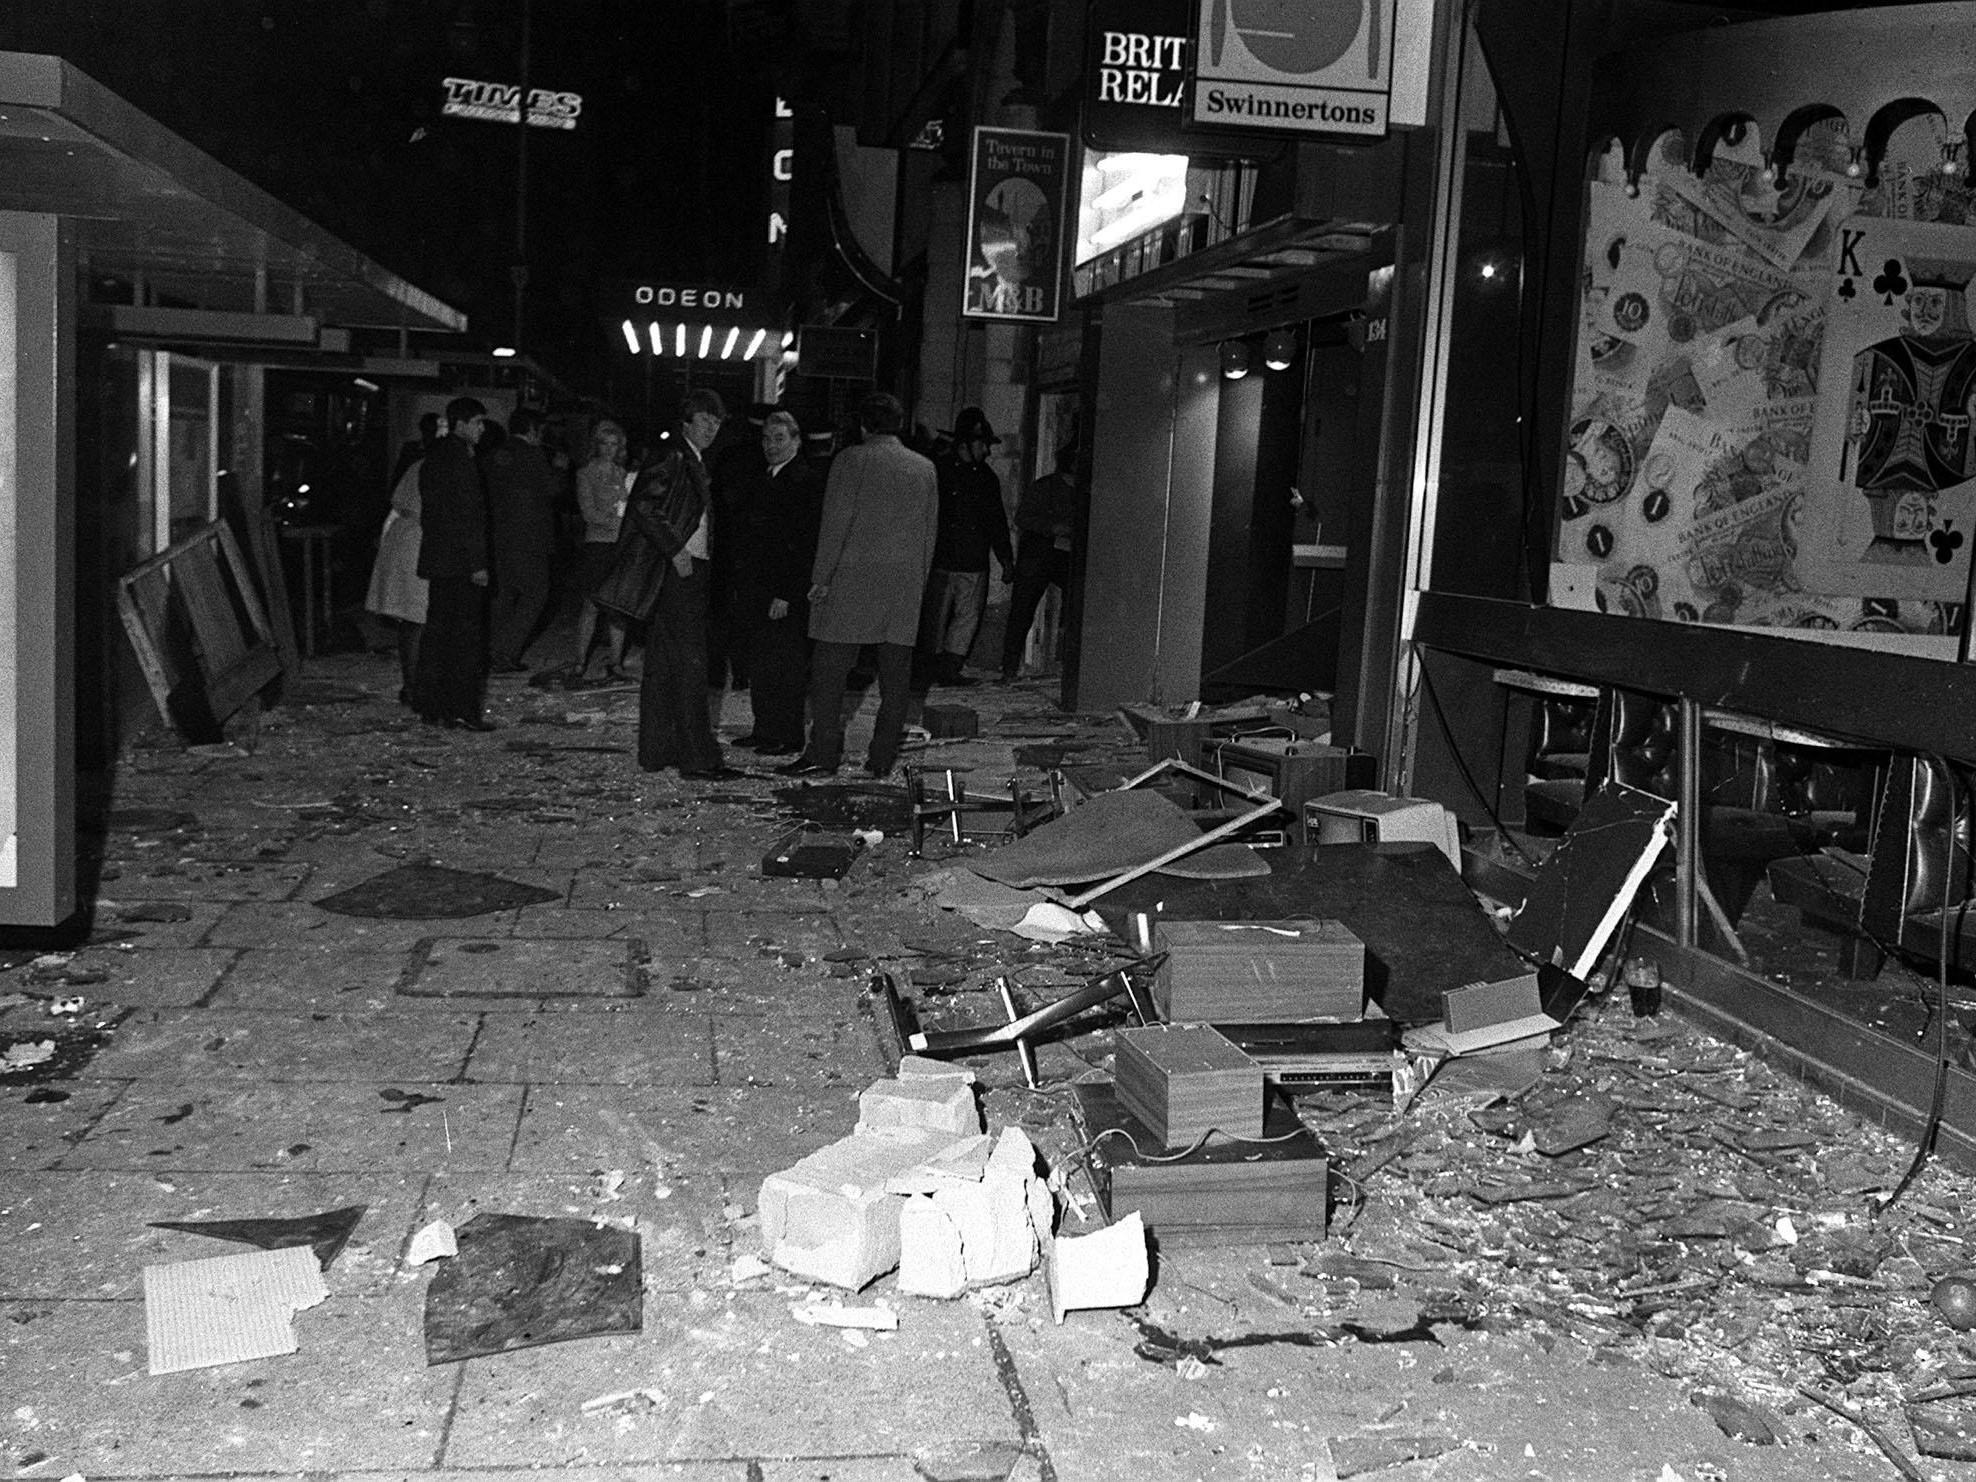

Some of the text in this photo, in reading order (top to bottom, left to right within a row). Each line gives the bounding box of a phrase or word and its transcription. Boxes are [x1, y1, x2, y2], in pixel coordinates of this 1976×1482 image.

[1102, 31, 1187, 70] BRIT
[1207, 89, 1376, 125] Swinnertons
[985, 139, 1055, 160] Tavern in
[987, 156, 1053, 175] the Town
[1838, 228, 1866, 278] K
[635, 286, 744, 309] ODEON
[976, 282, 1045, 315] M&B
[1620, 299, 1643, 322] 10
